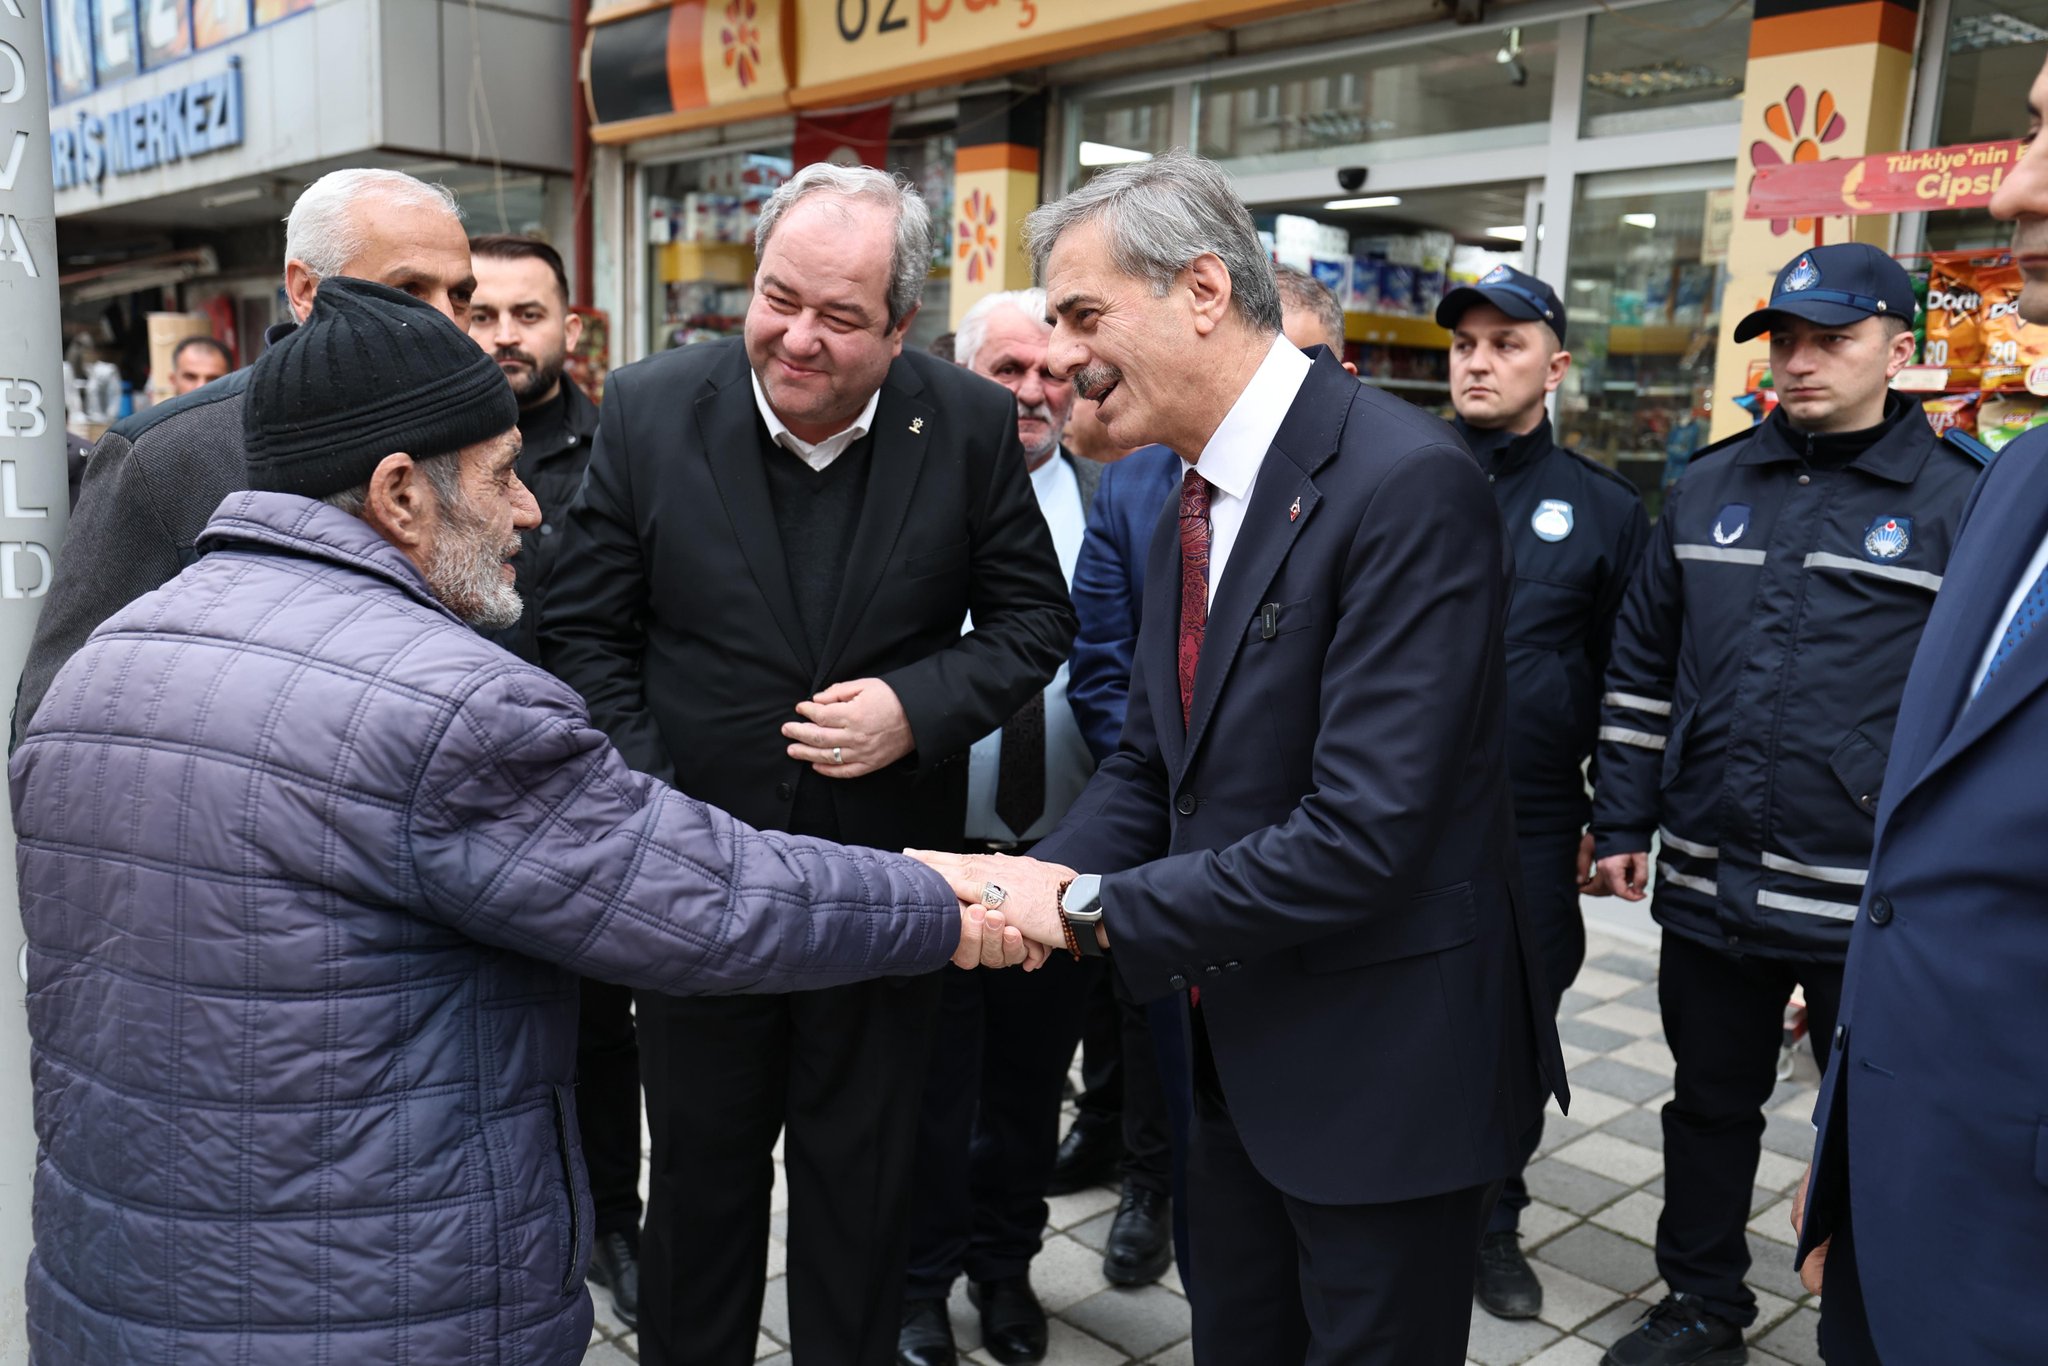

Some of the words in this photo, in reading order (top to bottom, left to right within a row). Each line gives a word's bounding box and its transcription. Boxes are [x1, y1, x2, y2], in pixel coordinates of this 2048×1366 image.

[105, 54, 244, 176] MERKEZİ
[1885, 146, 2008, 174] Türkiye'nin
[1915, 166, 2004, 206] Cipsl
[0, 377, 54, 600] BLD
